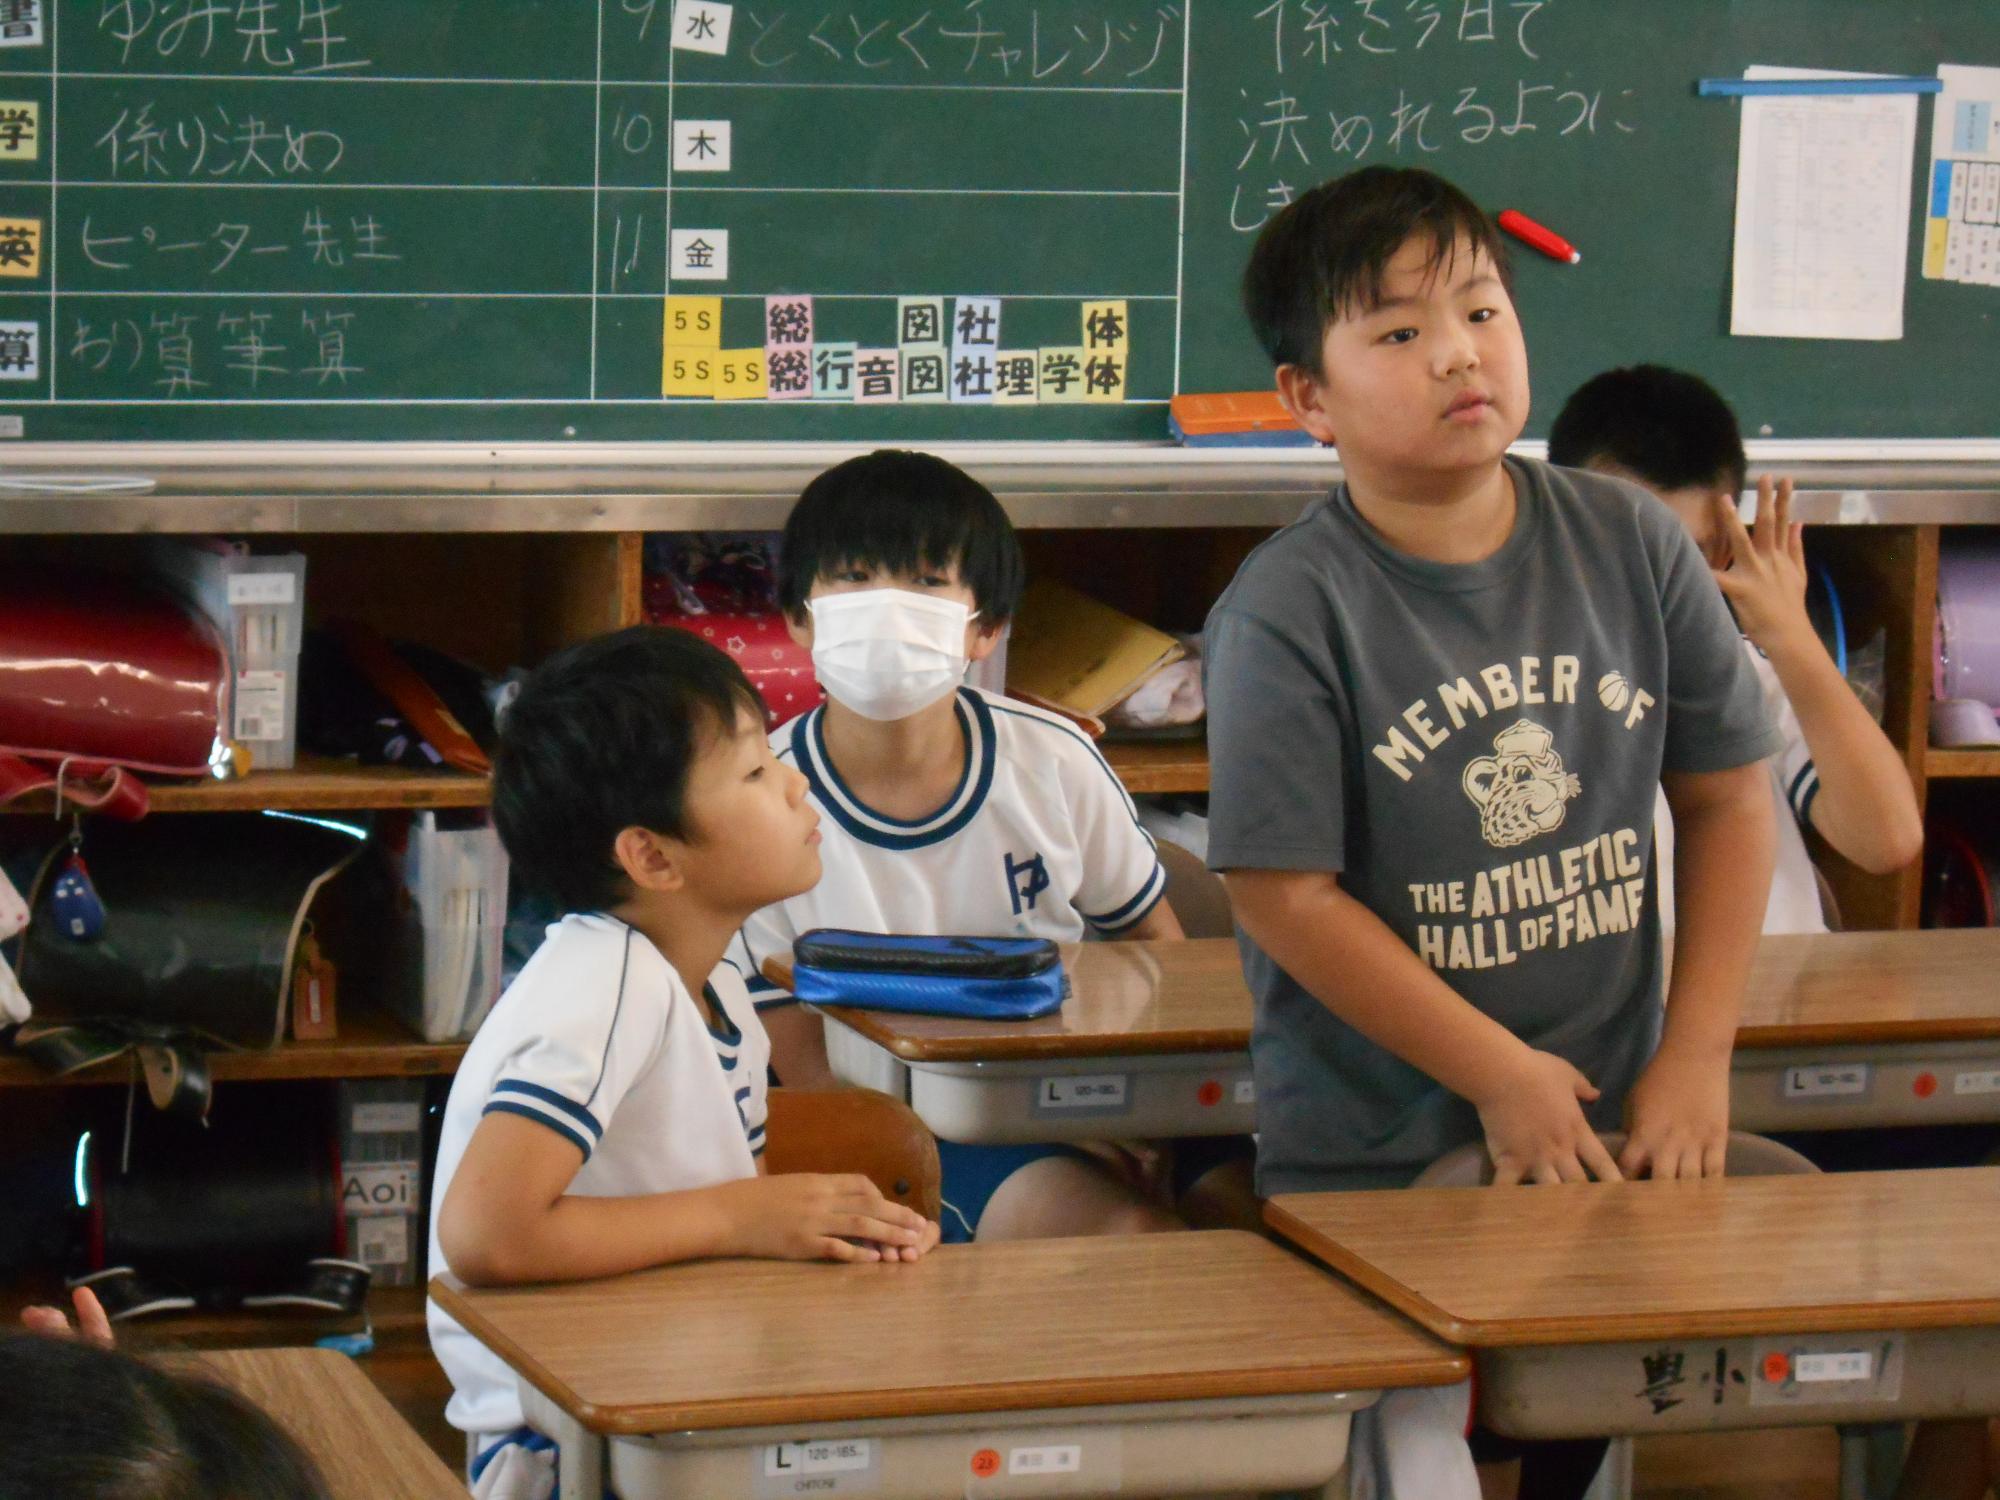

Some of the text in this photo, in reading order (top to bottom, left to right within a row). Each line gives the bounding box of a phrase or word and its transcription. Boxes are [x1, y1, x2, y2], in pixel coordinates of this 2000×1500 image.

[686, 9, 716, 40] 水
[94, 101, 345, 178] 係り決め
[611, 105, 653, 153] 10
[687, 128, 717, 161] 木
[82, 206, 401, 274] ピーター先生
[684, 237, 715, 269] 金
[902, 303, 940, 344] 図
[957, 303, 996, 345] 社
[1086, 307, 1124, 349] 体
[1372, 655, 1580, 782] MEMBER
[1408, 828, 1641, 918] THE ATHLETIC
[1418, 918, 1518, 970] HALL
[1519, 914, 1554, 951] OF
[1048, 1082, 1061, 1101] L
[344, 1174, 407, 1205] Aoi
[776, 1445, 792, 1469] L
